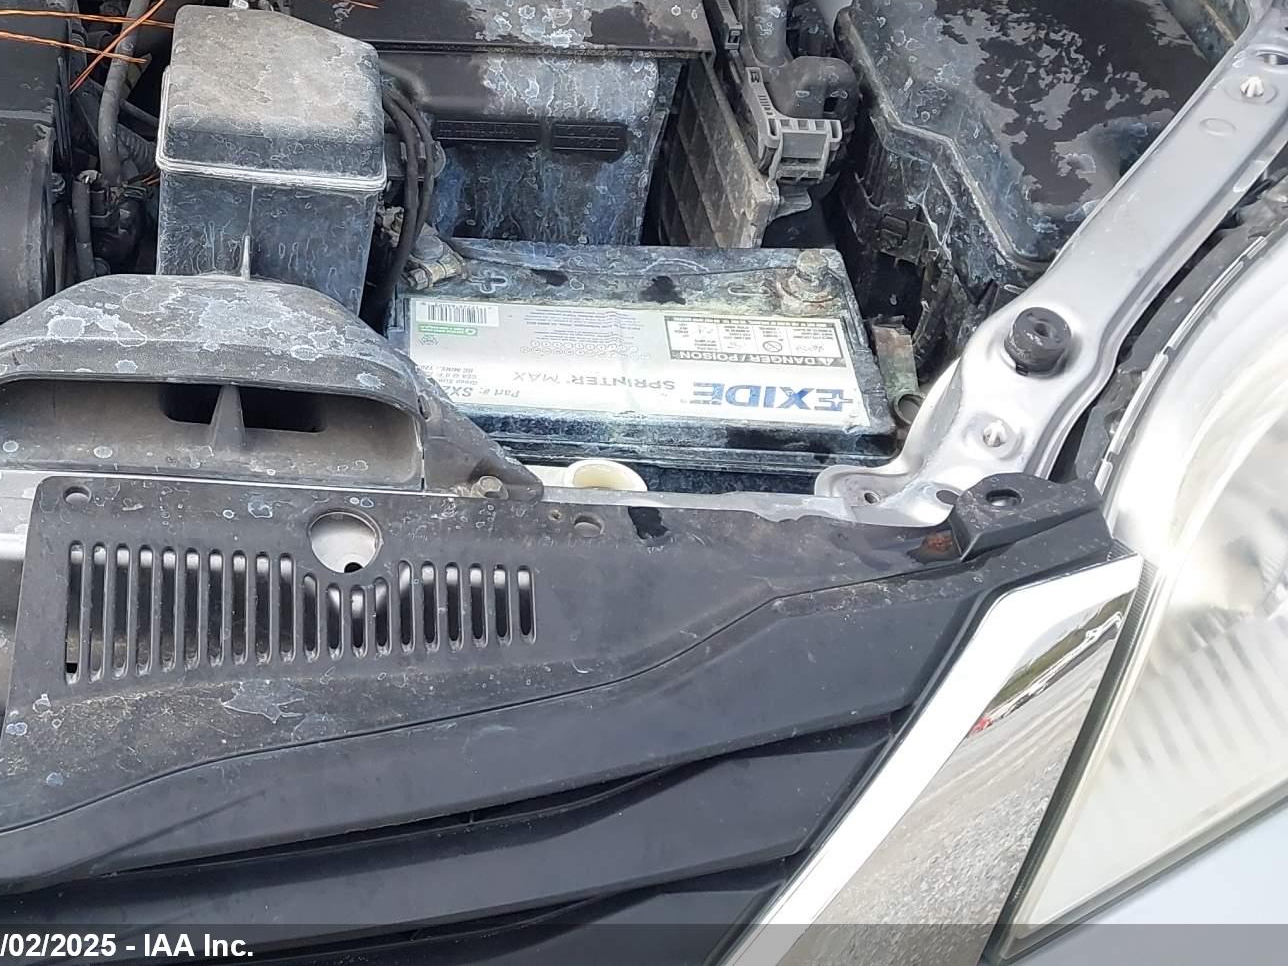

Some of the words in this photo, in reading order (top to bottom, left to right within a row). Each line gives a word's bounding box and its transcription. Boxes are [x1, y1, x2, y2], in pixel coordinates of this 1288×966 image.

[679, 351, 739, 362] POISON
[750, 355, 816, 366] DANGER
[513, 371, 559, 385] MAX
[494, 389, 520, 398] Part
[691, 382, 853, 412] EXIDE
